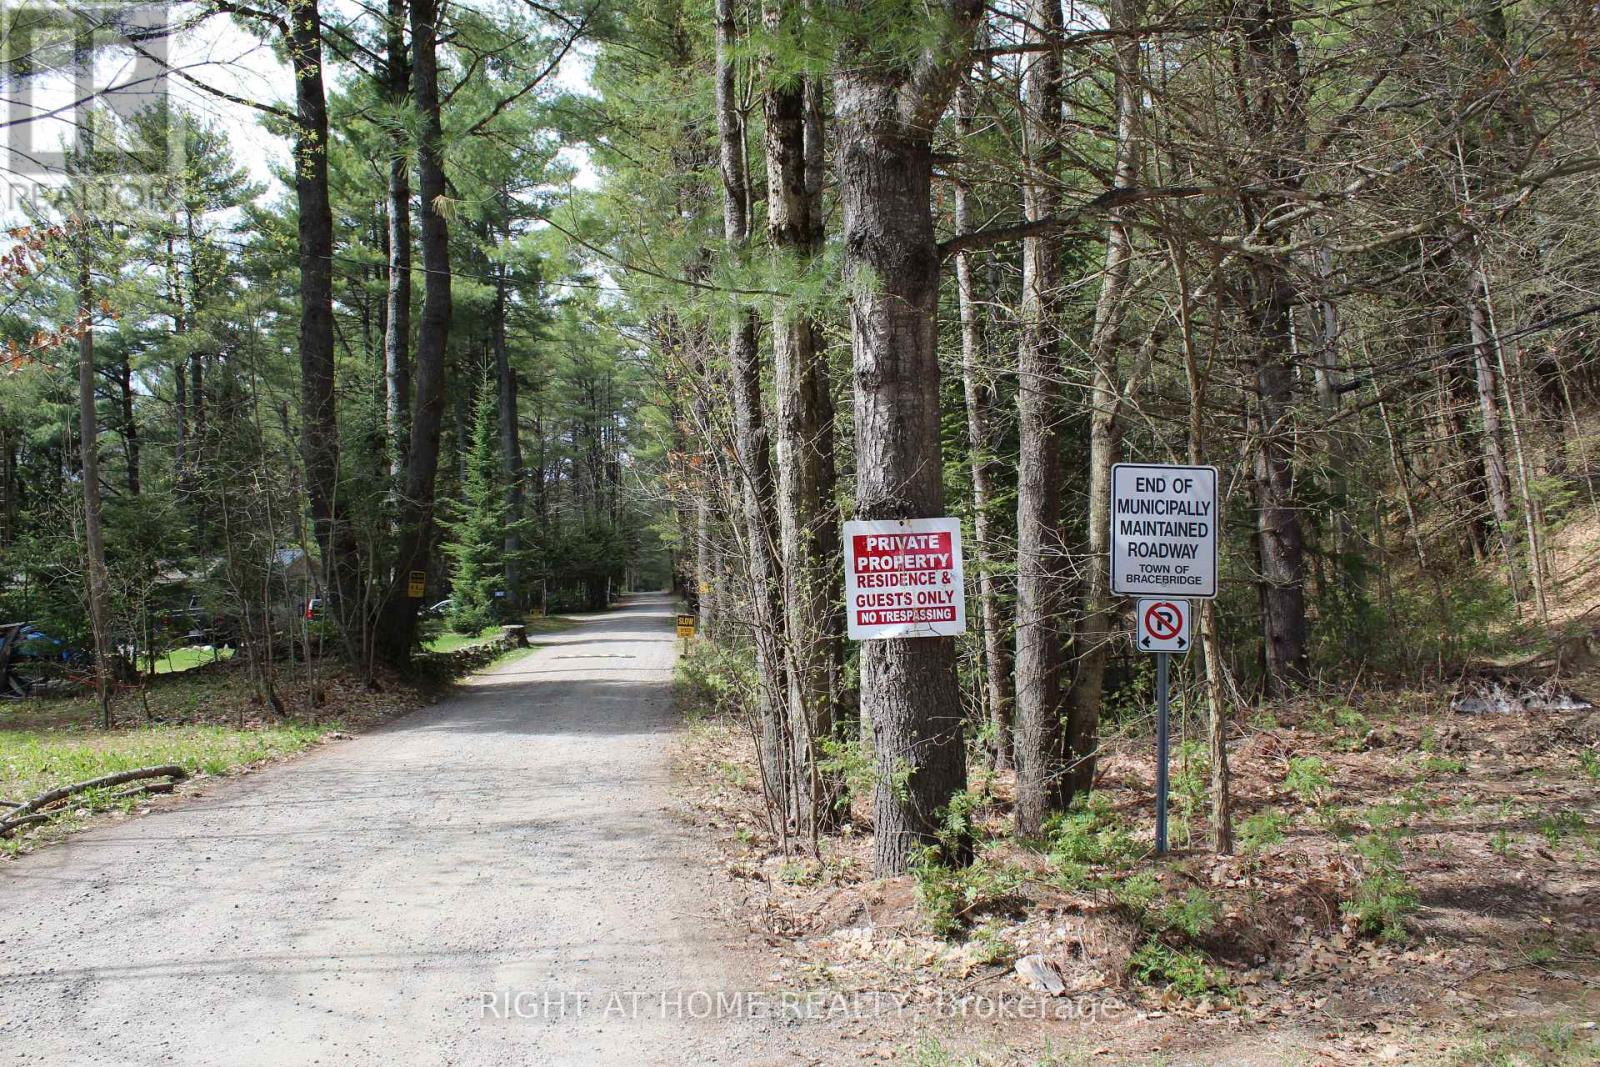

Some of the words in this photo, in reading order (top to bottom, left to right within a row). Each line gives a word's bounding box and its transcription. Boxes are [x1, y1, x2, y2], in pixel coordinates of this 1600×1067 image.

[1136, 477, 1166, 493] END
[1173, 478, 1193, 494] OF
[1117, 499, 1211, 516] MUNICIPALLY
[1120, 520, 1209, 537] MAINTAINED
[867, 535, 940, 551] PRIVATE
[1128, 542, 1199, 559] ROADWAY
[857, 553, 949, 570] PROPERTY
[1139, 564, 1170, 574] TOWN
[1175, 565, 1190, 574] OF
[857, 572, 936, 588] RESIDENCE
[941, 571, 951, 584] &
[1126, 575, 1202, 585] BRACEBRIDGE
[856, 592, 913, 608] GUESTS
[917, 590, 954, 605] ONLY
[679, 617, 694, 625] SLOW
[861, 612, 877, 624] NO
[879, 608, 951, 622] TRESPASSING
